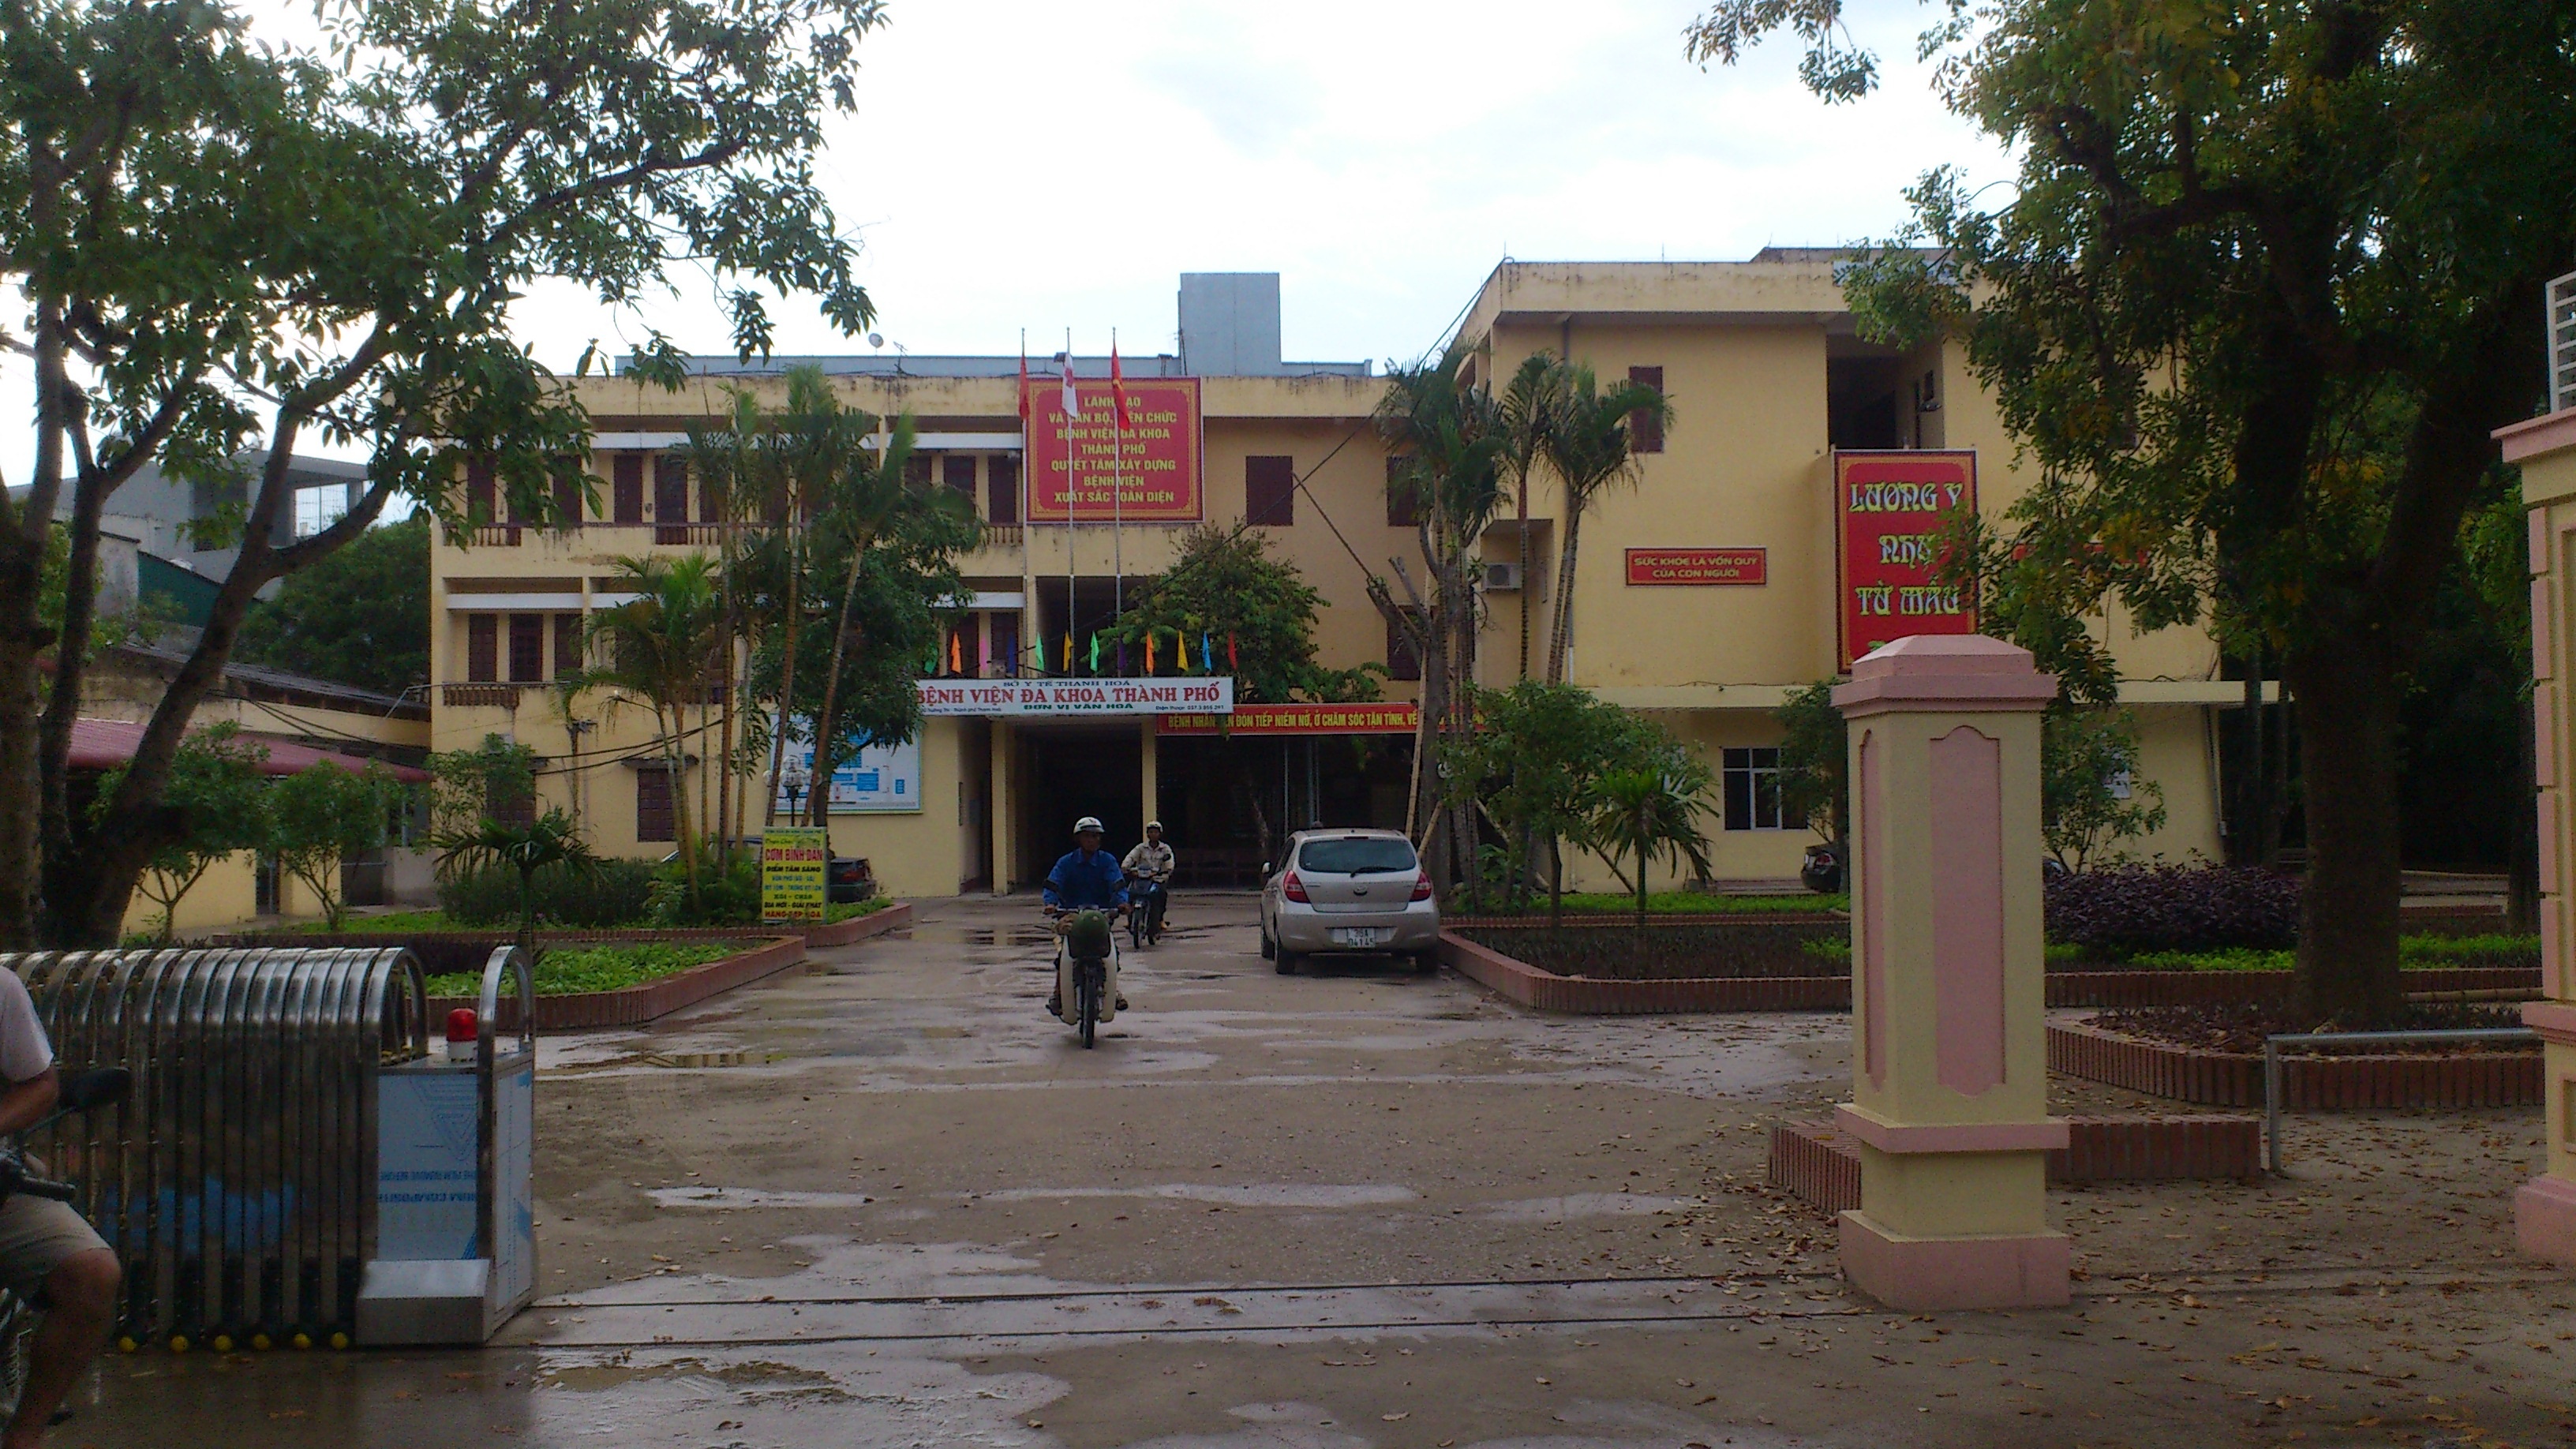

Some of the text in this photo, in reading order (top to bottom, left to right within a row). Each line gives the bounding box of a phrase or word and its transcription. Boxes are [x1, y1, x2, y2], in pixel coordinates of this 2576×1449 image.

[1048, 410, 1064, 424] VÀ
[1068, 410, 1091, 424] ÁN
[1146, 410, 1177, 424] CHỨC
[1056, 427, 1088, 440] BỆNH
[1090, 427, 1116, 440] VIỆN
[1139, 428, 1170, 439] KHOA
[1122, 441, 1146, 455] PHỐ
[1090, 459, 1115, 470] TÂM
[1119, 459, 1140, 470] XÂY
[1144, 459, 1176, 472] DỰNG
[1084, 474, 1144, 488] BỆNH VIỆN
[1087, 489, 1110, 503] SẮC
[1146, 490, 1174, 504] DIỆN
[1708, 554, 1732, 566] VỐN
[1677, 569, 1702, 578] CON
[916, 680, 1220, 706] BỆNH VIỆN ĐA KHOA THÀNH PHỐ
[1255, 710, 1273, 727] TIẾP
[1348, 710, 1365, 726] SÓC
[1366, 710, 1383, 728] TẬN
